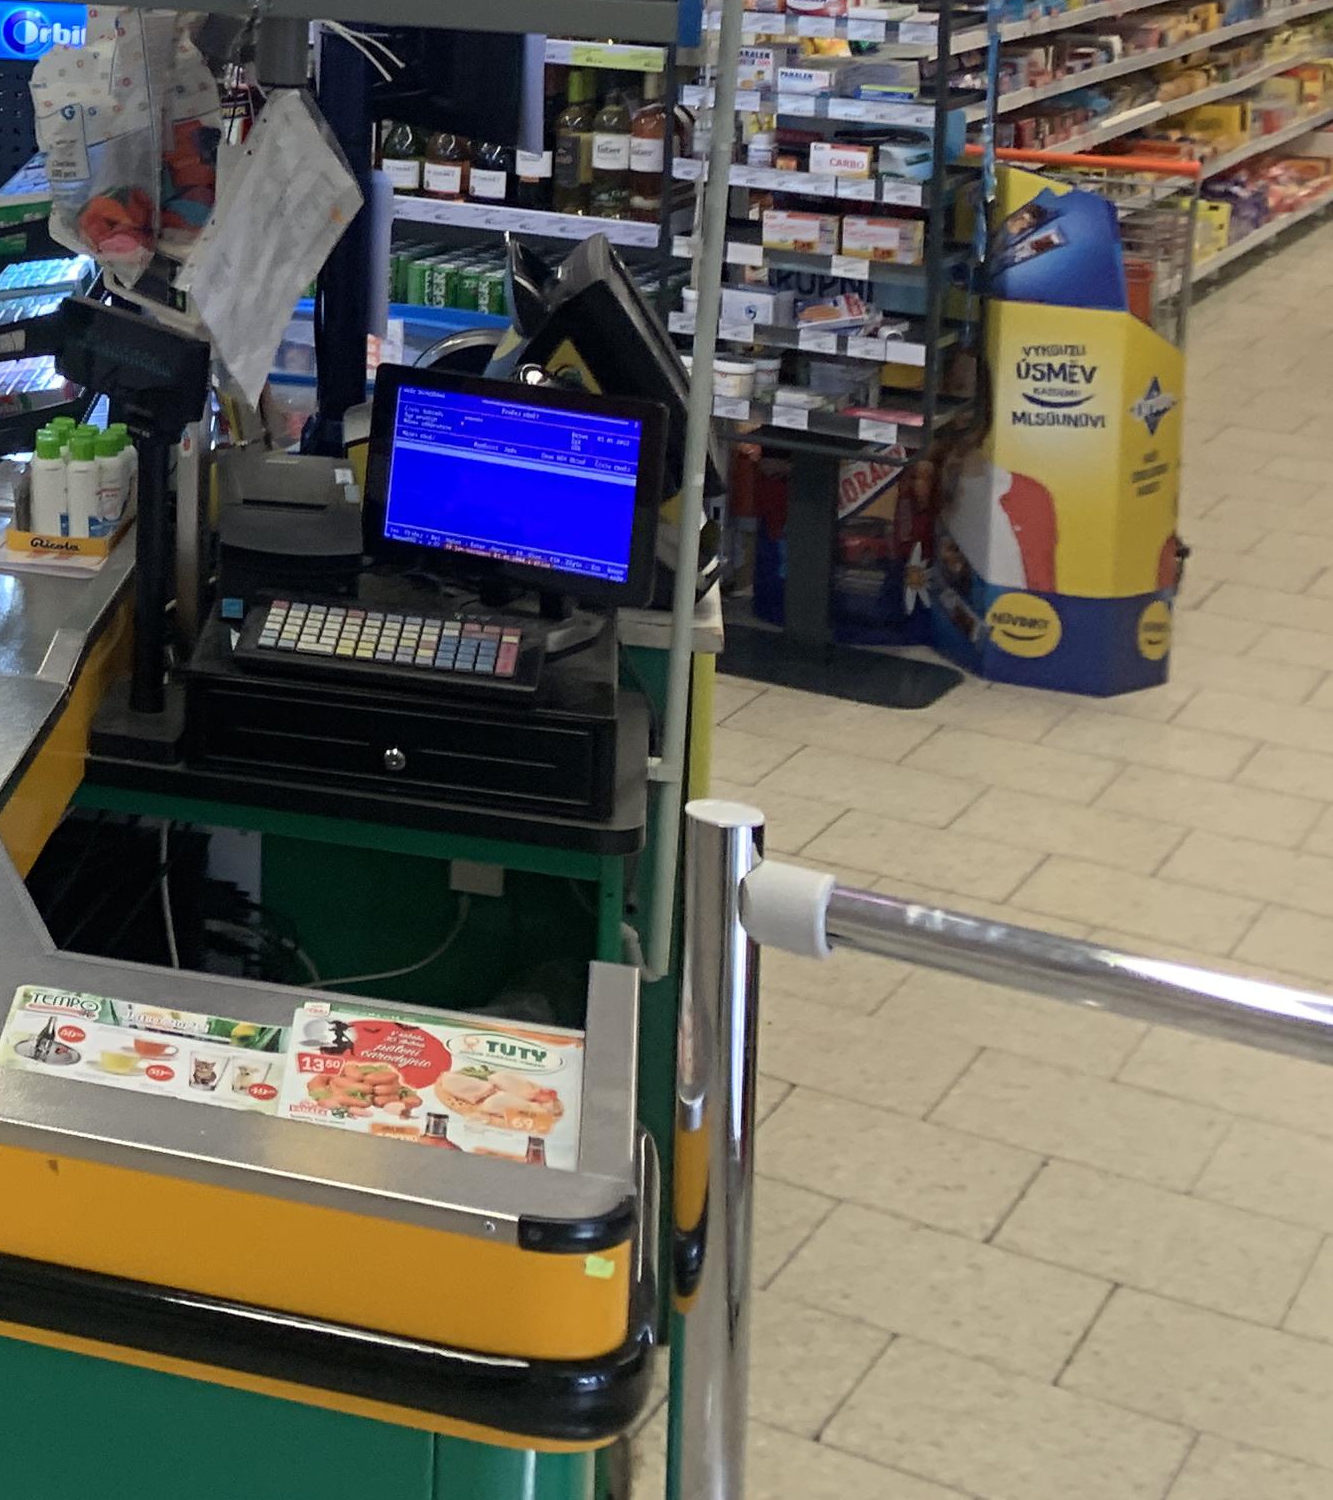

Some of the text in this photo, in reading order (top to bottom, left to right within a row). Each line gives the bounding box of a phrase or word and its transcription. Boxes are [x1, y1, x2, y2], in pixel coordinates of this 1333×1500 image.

[780, 70, 814, 81] PARALEN
[829, 157, 865, 169] CARBO
[1015, 358, 1097, 384] ÚSMĚV
[1012, 411, 1106, 429] MLSOUNOVI
[30, 536, 81, 552] Ricola
[31, 992, 101, 1012] TEMPO
[485, 1039, 548, 1063] TUTY
